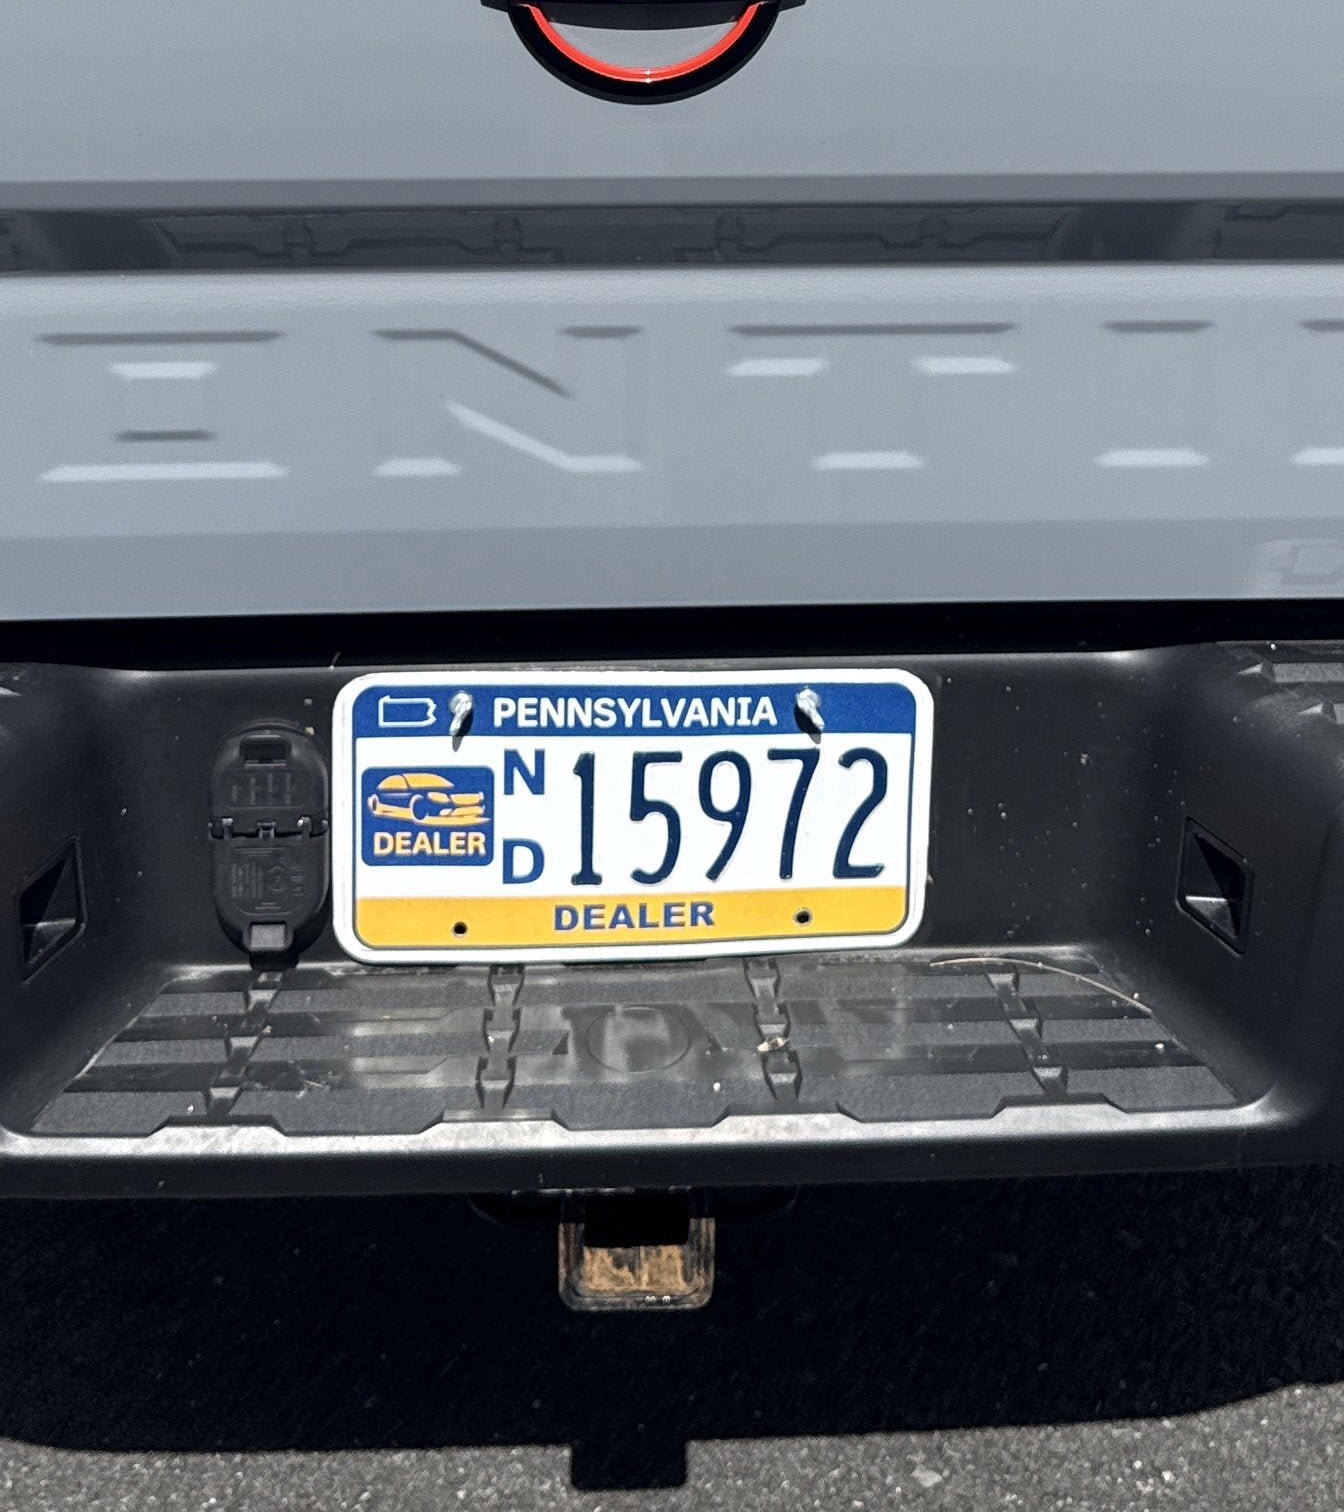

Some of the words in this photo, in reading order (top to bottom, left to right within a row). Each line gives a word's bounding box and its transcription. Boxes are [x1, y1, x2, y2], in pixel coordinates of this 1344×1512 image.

[493, 695, 778, 729] PENNSYLVANIA
[571, 746, 889, 887] 15972
[373, 831, 487, 856] DEALER
[554, 900, 716, 932] DEALER
